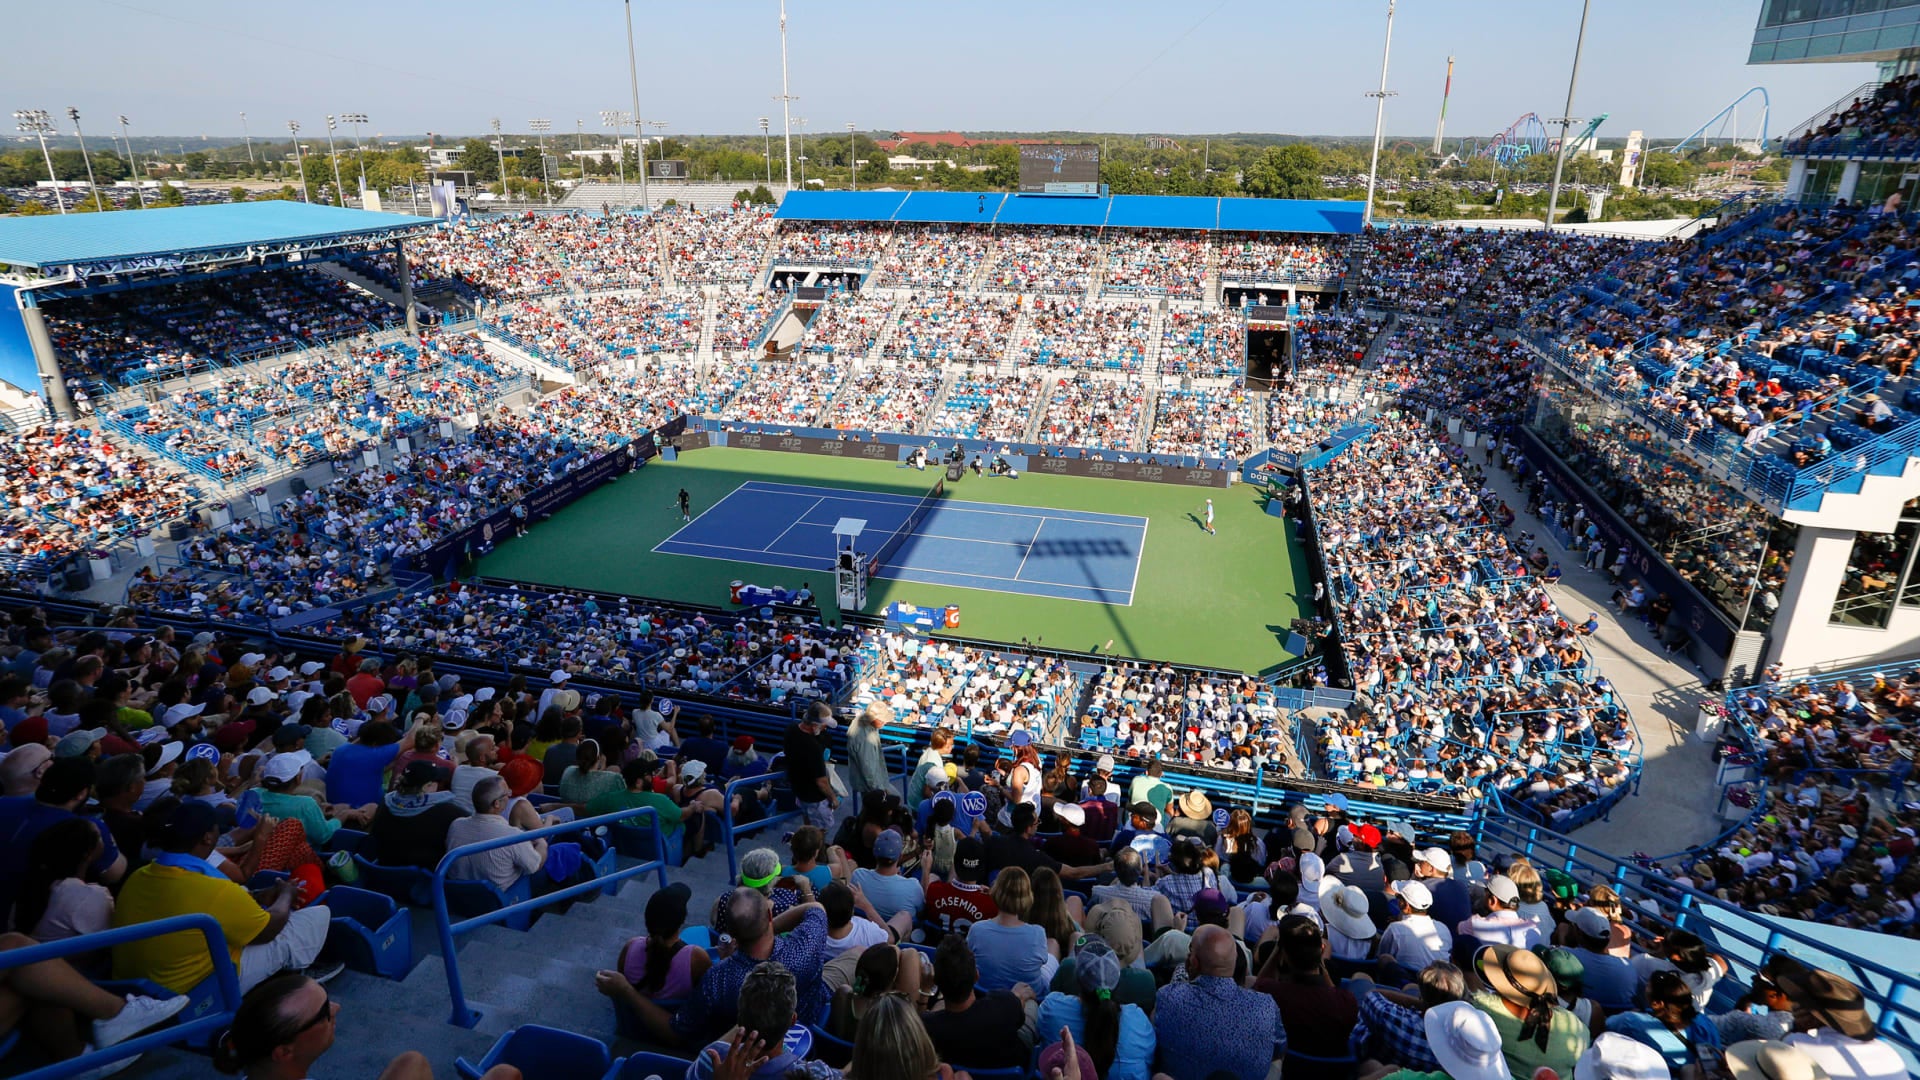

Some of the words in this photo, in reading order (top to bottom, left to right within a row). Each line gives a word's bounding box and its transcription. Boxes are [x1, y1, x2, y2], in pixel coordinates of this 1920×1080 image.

[740, 435, 761, 444] ATP
[780, 438, 801, 447] ATP
[821, 441, 843, 450] ATP
[863, 444, 886, 454] ATP
[1042, 458, 1067, 468] ATP
[1271, 452, 1292, 464] DOBEL
[1089, 463, 1114, 472] ATP
[1137, 466, 1162, 476] ATP
[1186, 470, 1212, 480] ATP
[963, 797, 985, 812] W&S
[935, 896, 983, 920] CASEMIRO
